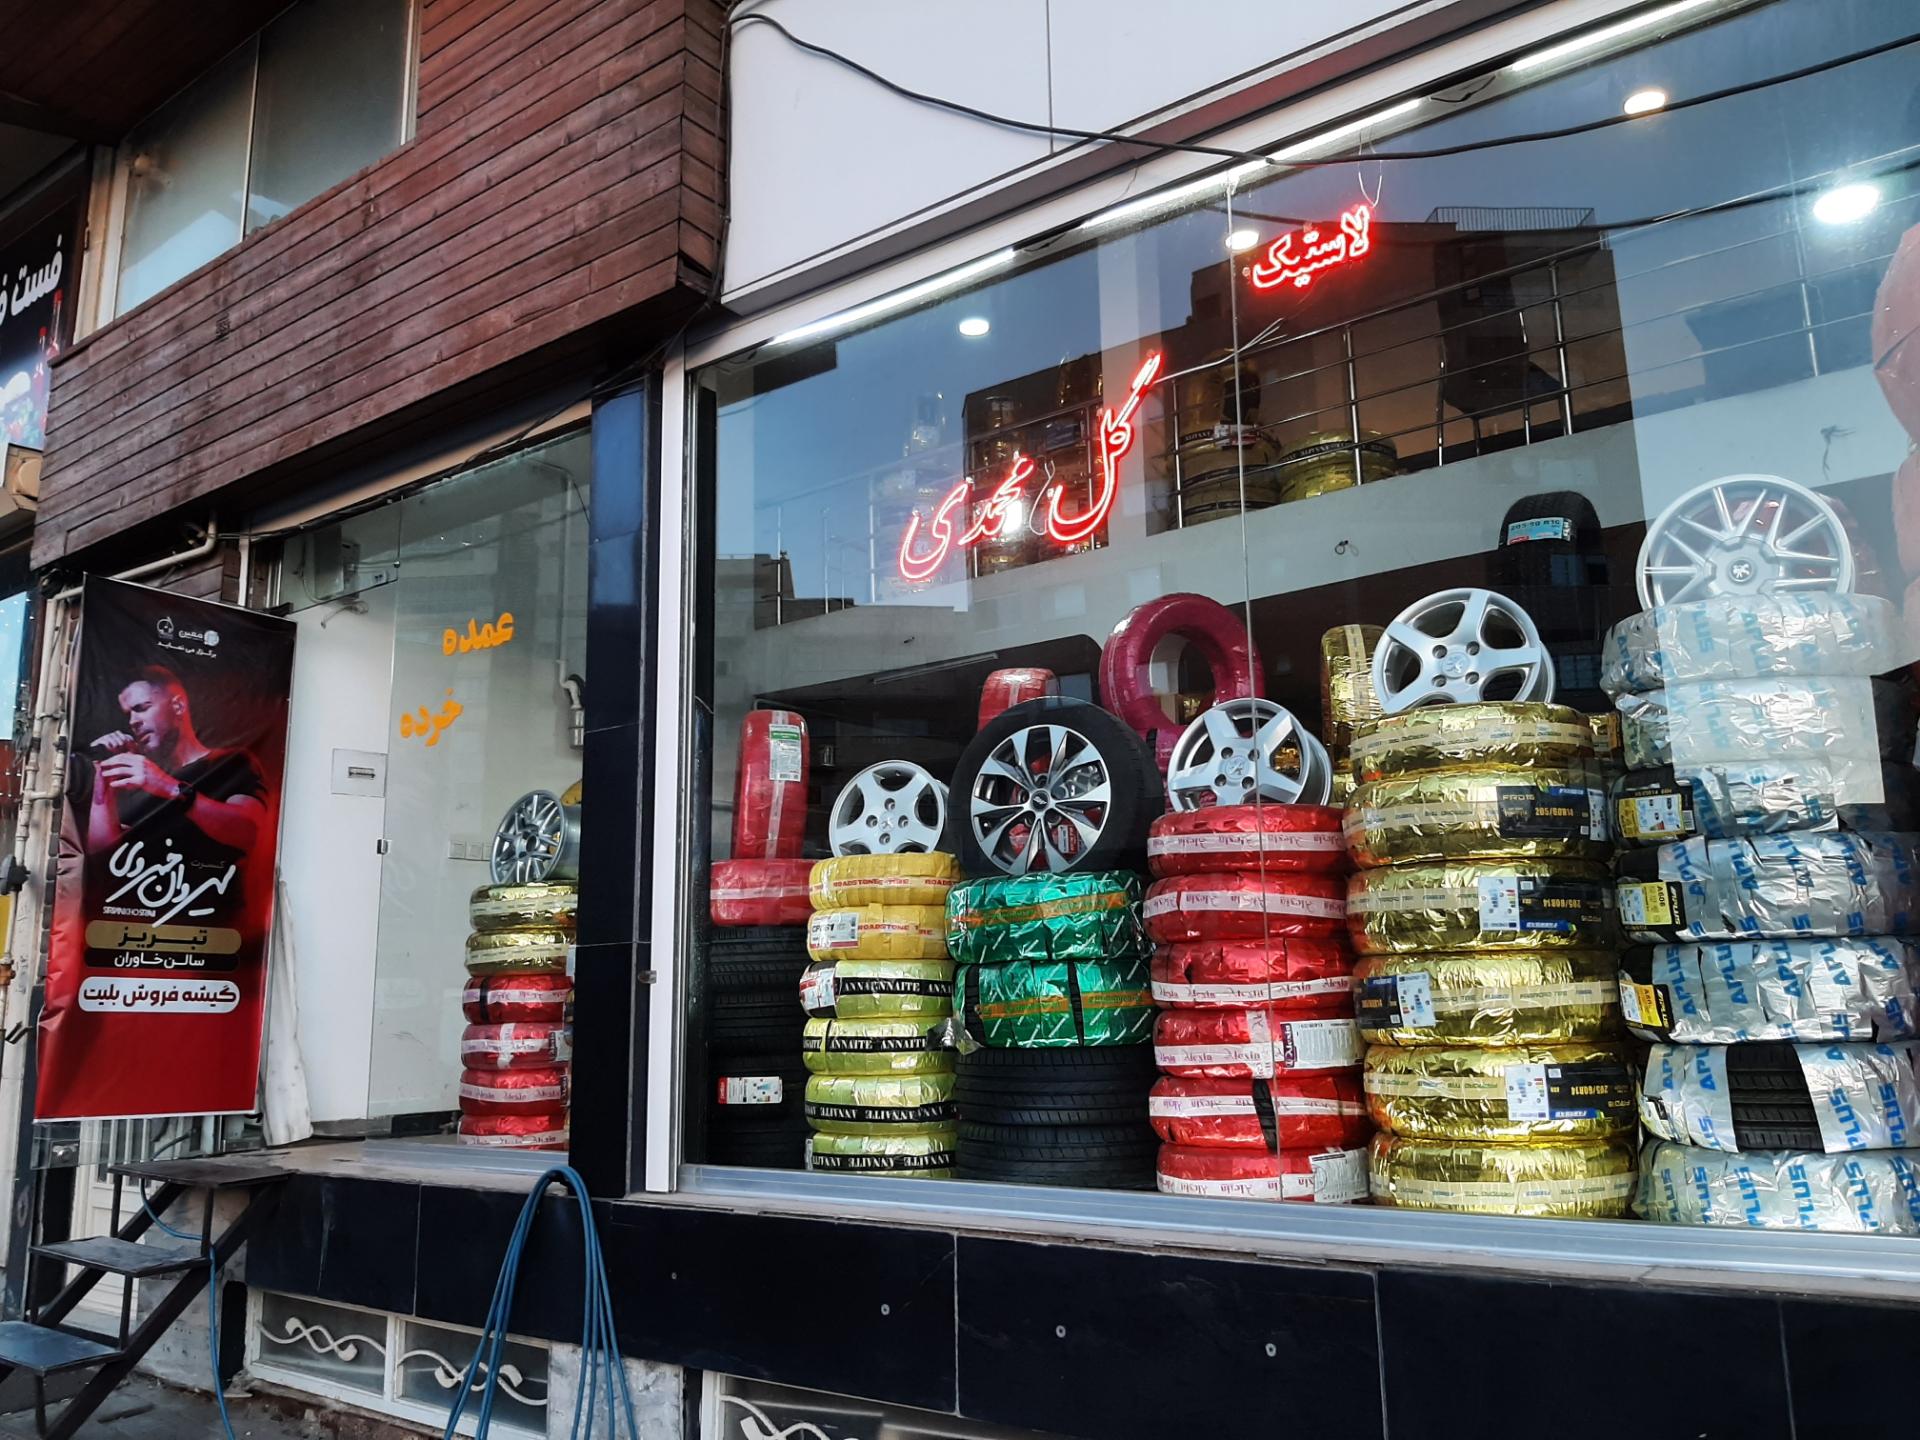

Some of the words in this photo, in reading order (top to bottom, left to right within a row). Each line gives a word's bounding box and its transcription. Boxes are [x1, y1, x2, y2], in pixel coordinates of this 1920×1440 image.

[11, 233, 63, 317] فست
[1252, 203, 1373, 290] لاستیک
[1047, 352, 1164, 542] گل
[442, 612, 514, 657] عمده
[400, 687, 464, 748] خرده
[113, 950, 163, 968] خاوران
[118, 926, 209, 951] تبریز
[163, 953, 205, 969] سالن
[83, 983, 121, 1006] بلیت
[122, 983, 179, 1007] فروش
[182, 985, 237, 1008] گیشه
[1665, 945, 1698, 1016] APLUS
[1715, 944, 1749, 1006] APLU
[1828, 1087, 1866, 1150] PLUS
[1877, 1082, 1907, 1148] PLUS
[1692, 1166, 1714, 1224] PLUS
[1734, 1166, 1767, 1226] PLUS
[1788, 1164, 1818, 1229] PLUS
[1843, 1161, 1879, 1229] PLUS
